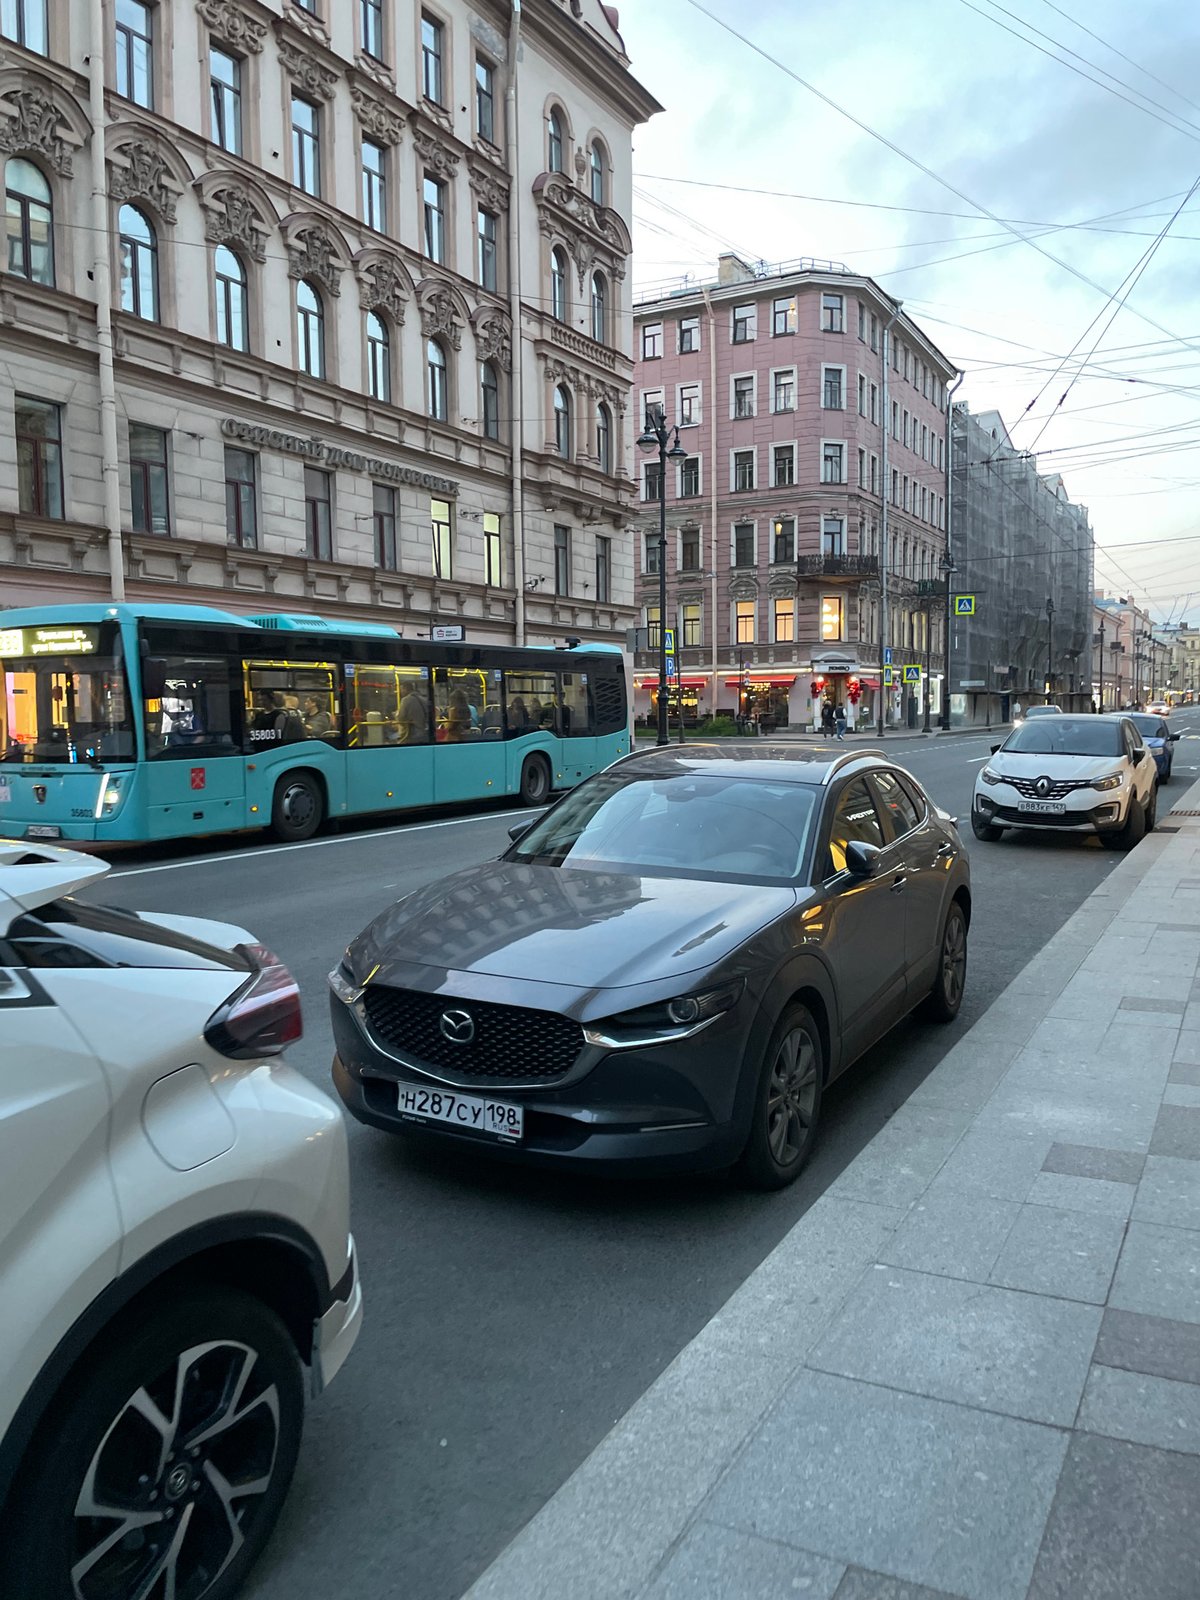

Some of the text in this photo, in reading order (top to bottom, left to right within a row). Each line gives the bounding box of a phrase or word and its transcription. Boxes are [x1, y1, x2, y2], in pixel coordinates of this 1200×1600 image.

[221, 418, 325, 460] ОФИСНЫЙ
[325, 446, 368, 472] ДОМ
[250, 729, 275, 740] 35803
[405, 1090, 516, 1126] Н287СУ 198
[493, 1122, 508, 1132] RUS
